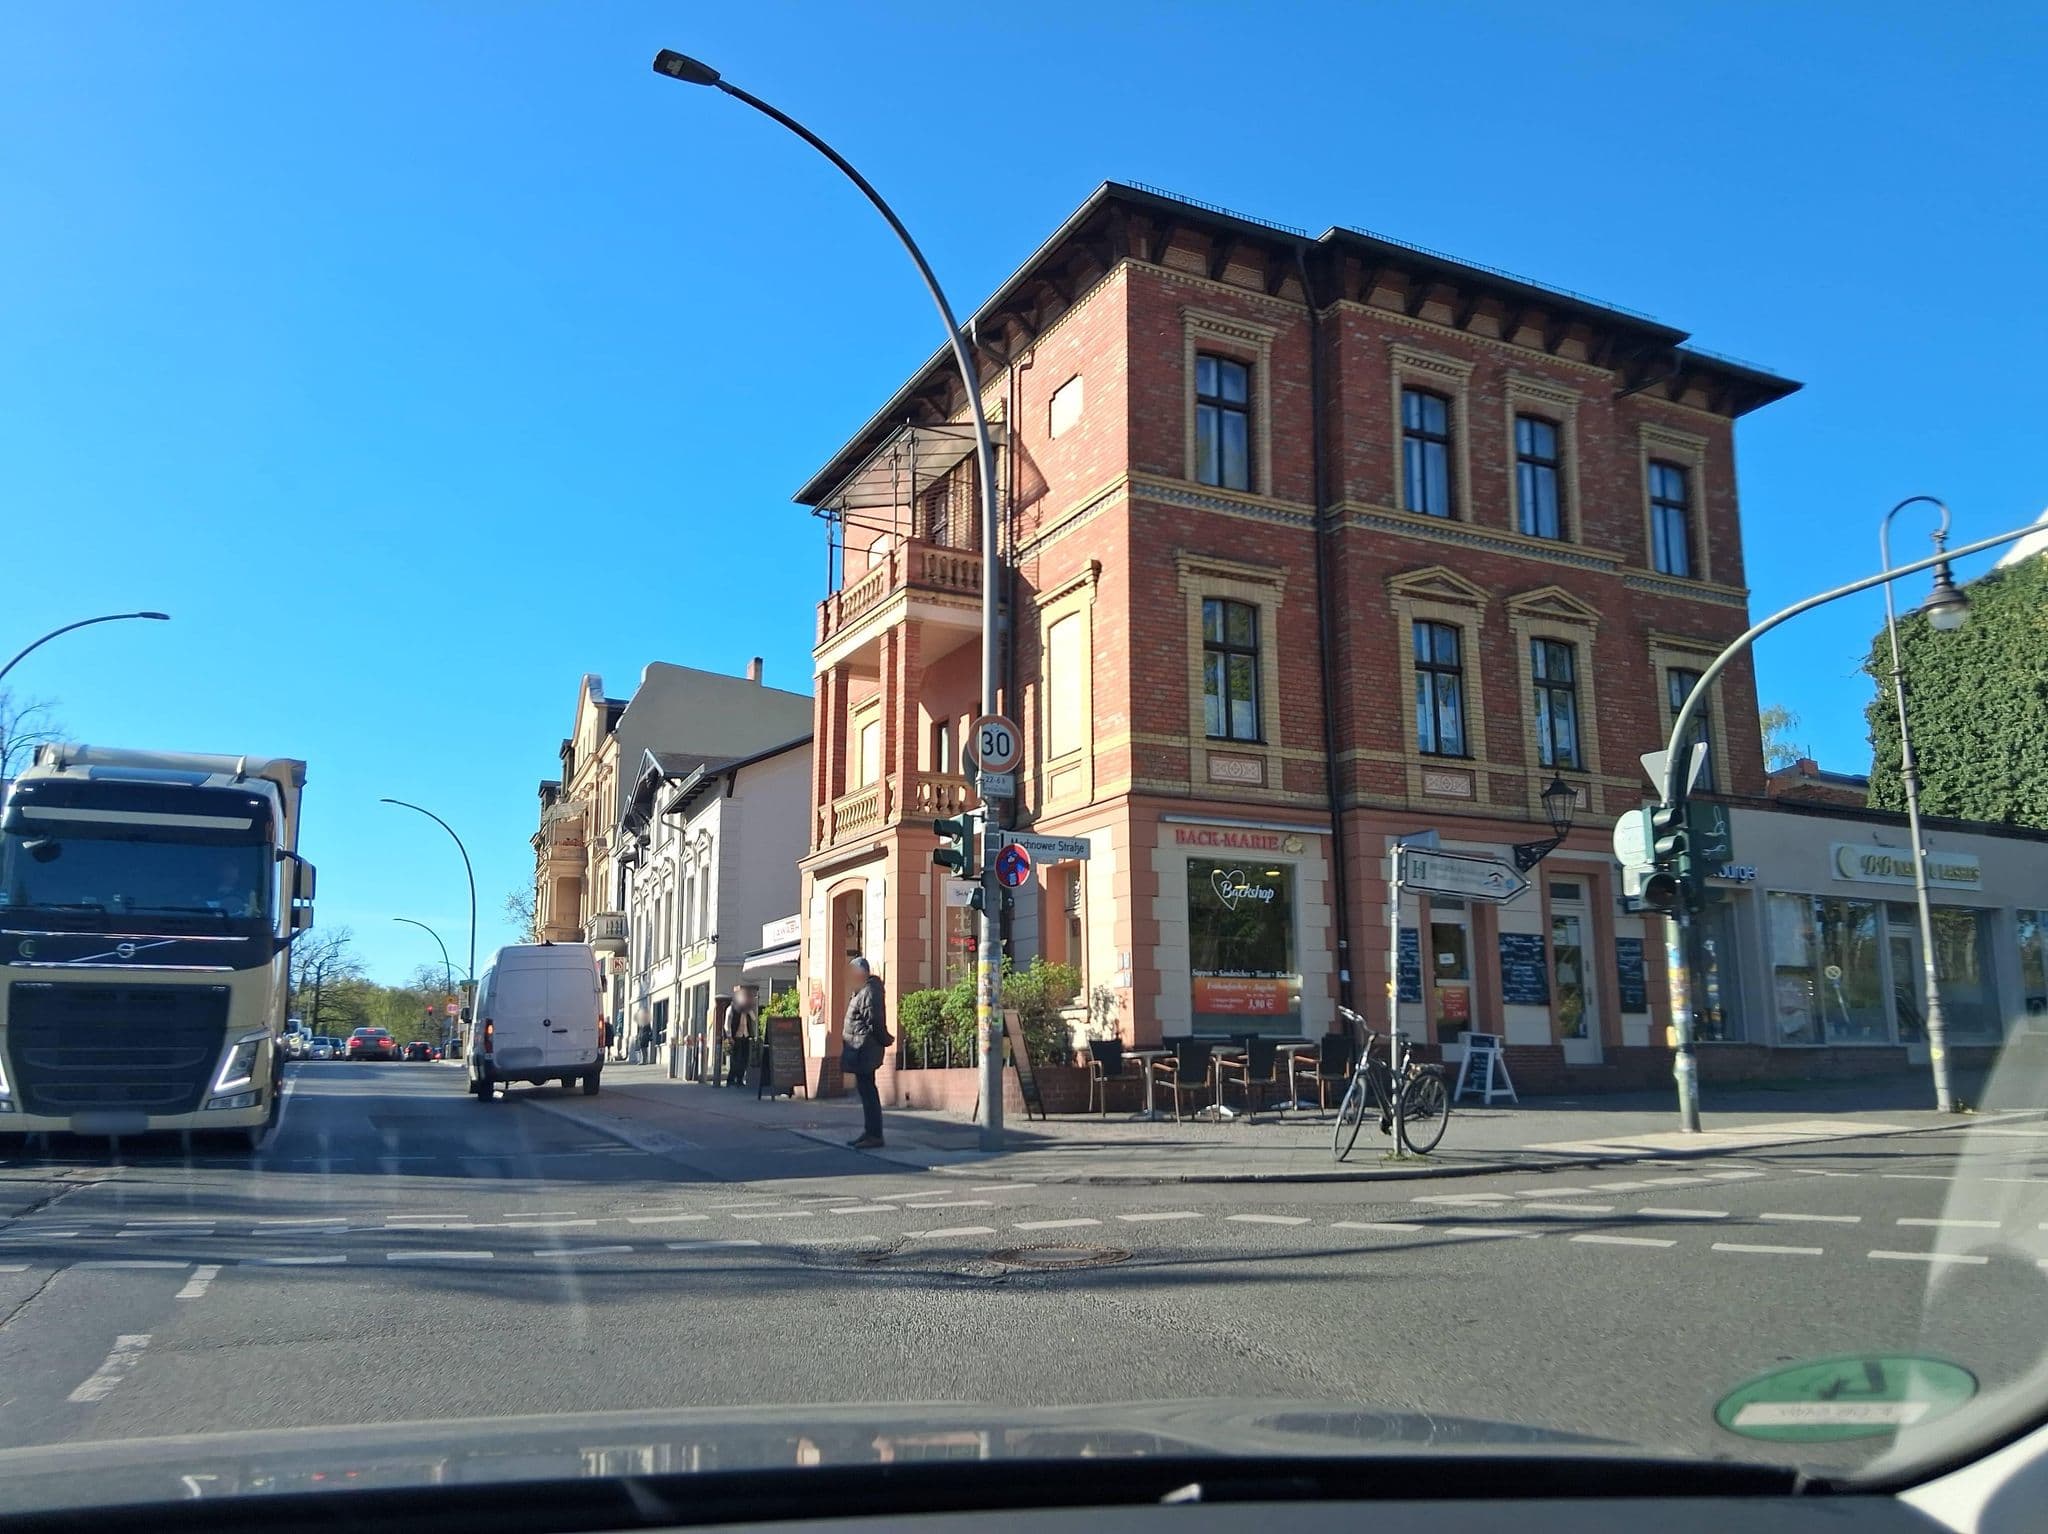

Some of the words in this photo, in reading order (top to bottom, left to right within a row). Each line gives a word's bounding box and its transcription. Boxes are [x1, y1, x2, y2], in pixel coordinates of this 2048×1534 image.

[981, 731, 1010, 757] 30
[1010, 838, 1056, 850] Mchnower
[1058, 840, 1085, 855] Straße
[1220, 880, 1275, 904] Backshop
